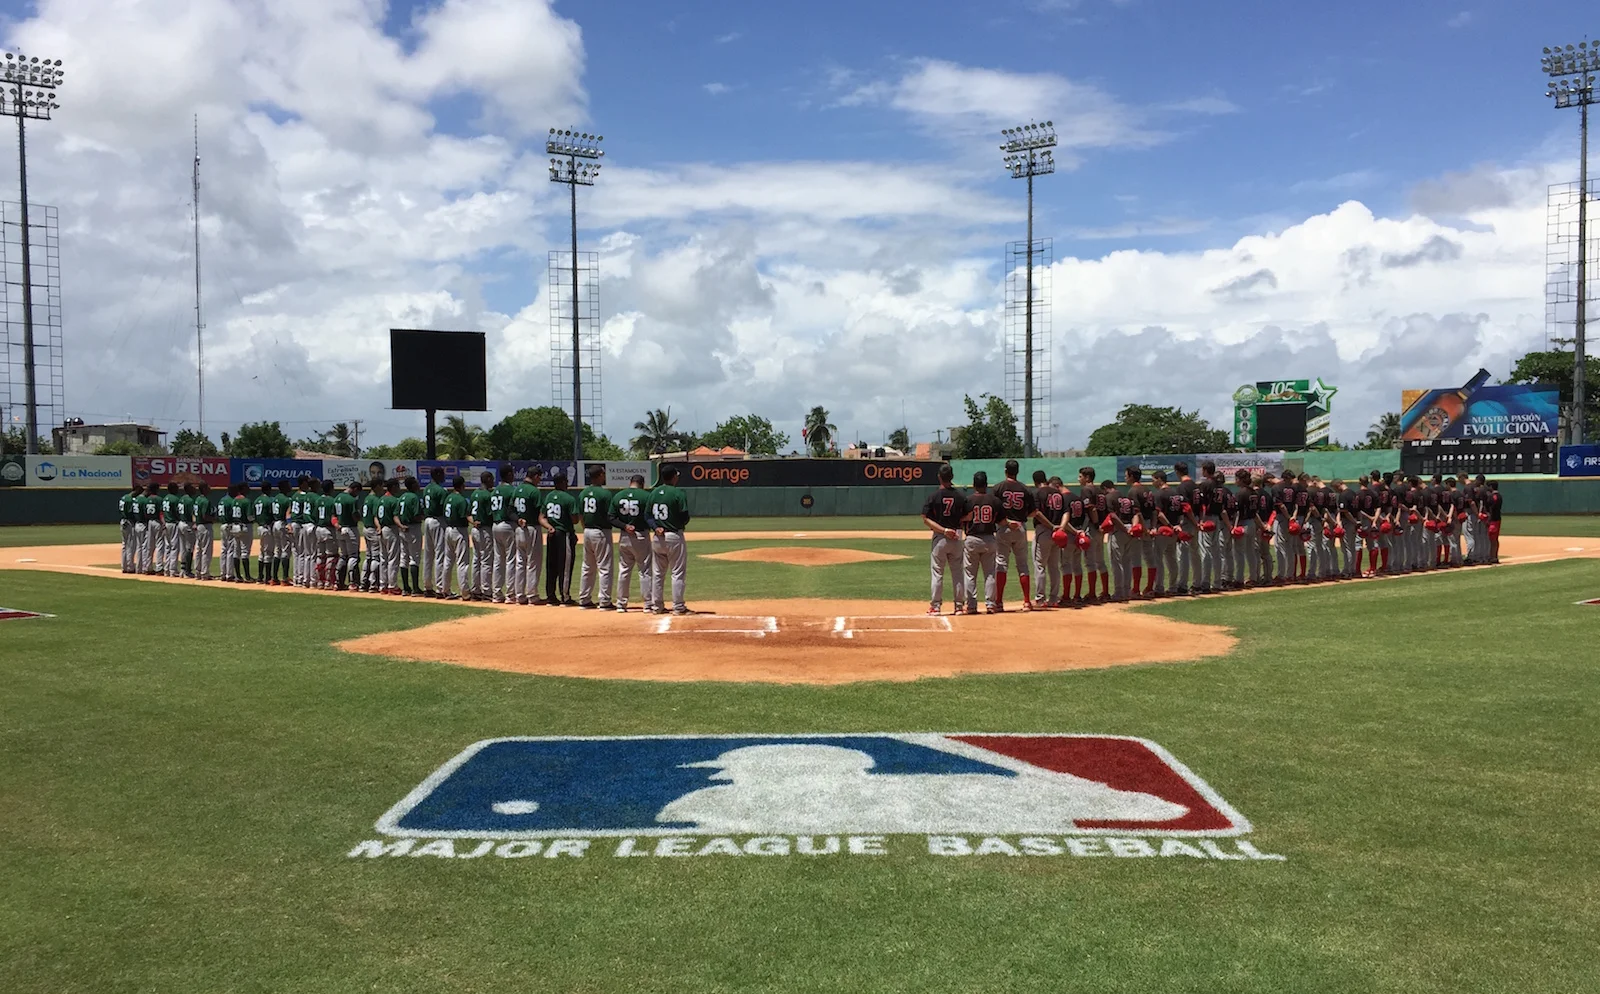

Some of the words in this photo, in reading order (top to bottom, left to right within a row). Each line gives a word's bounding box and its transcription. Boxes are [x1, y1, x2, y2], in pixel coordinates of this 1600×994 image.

[1270, 381, 1296, 400] 105
[1472, 415, 1509, 424] NUESTRA
[1511, 413, 1541, 422] PASIÓN
[1463, 421, 1550, 436] EVOLUCIONA
[62, 469, 76, 478] La
[79, 469, 122, 478] Nacional
[151, 459, 228, 475] SIRENA
[264, 469, 312, 479] POPULAR
[691, 465, 749, 483] Orange
[864, 464, 923, 482] Orange
[292, 501, 300, 514] 15
[425, 495, 430, 508] 6
[472, 500, 478, 515] 2
[491, 496, 503, 511] 37
[514, 498, 526, 513] 46
[584, 497, 597, 513] 19
[619, 499, 639, 516] 35
[942, 497, 954, 516] 7
[1003, 491, 1024, 509] 35
[1047, 493, 1063, 510] 40
[255, 503, 263, 515] 17
[318, 507, 326, 519] 11
[363, 505, 368, 517] 9
[400, 502, 405, 515] 7
[445, 504, 451, 518] 5
[546, 503, 562, 519] 29
[652, 504, 669, 520] 43
[973, 505, 992, 523] 18
[346, 838, 591, 859] MAJOR
[611, 836, 890, 857] LEAGUE
[927, 835, 1287, 862] BASEBALL
